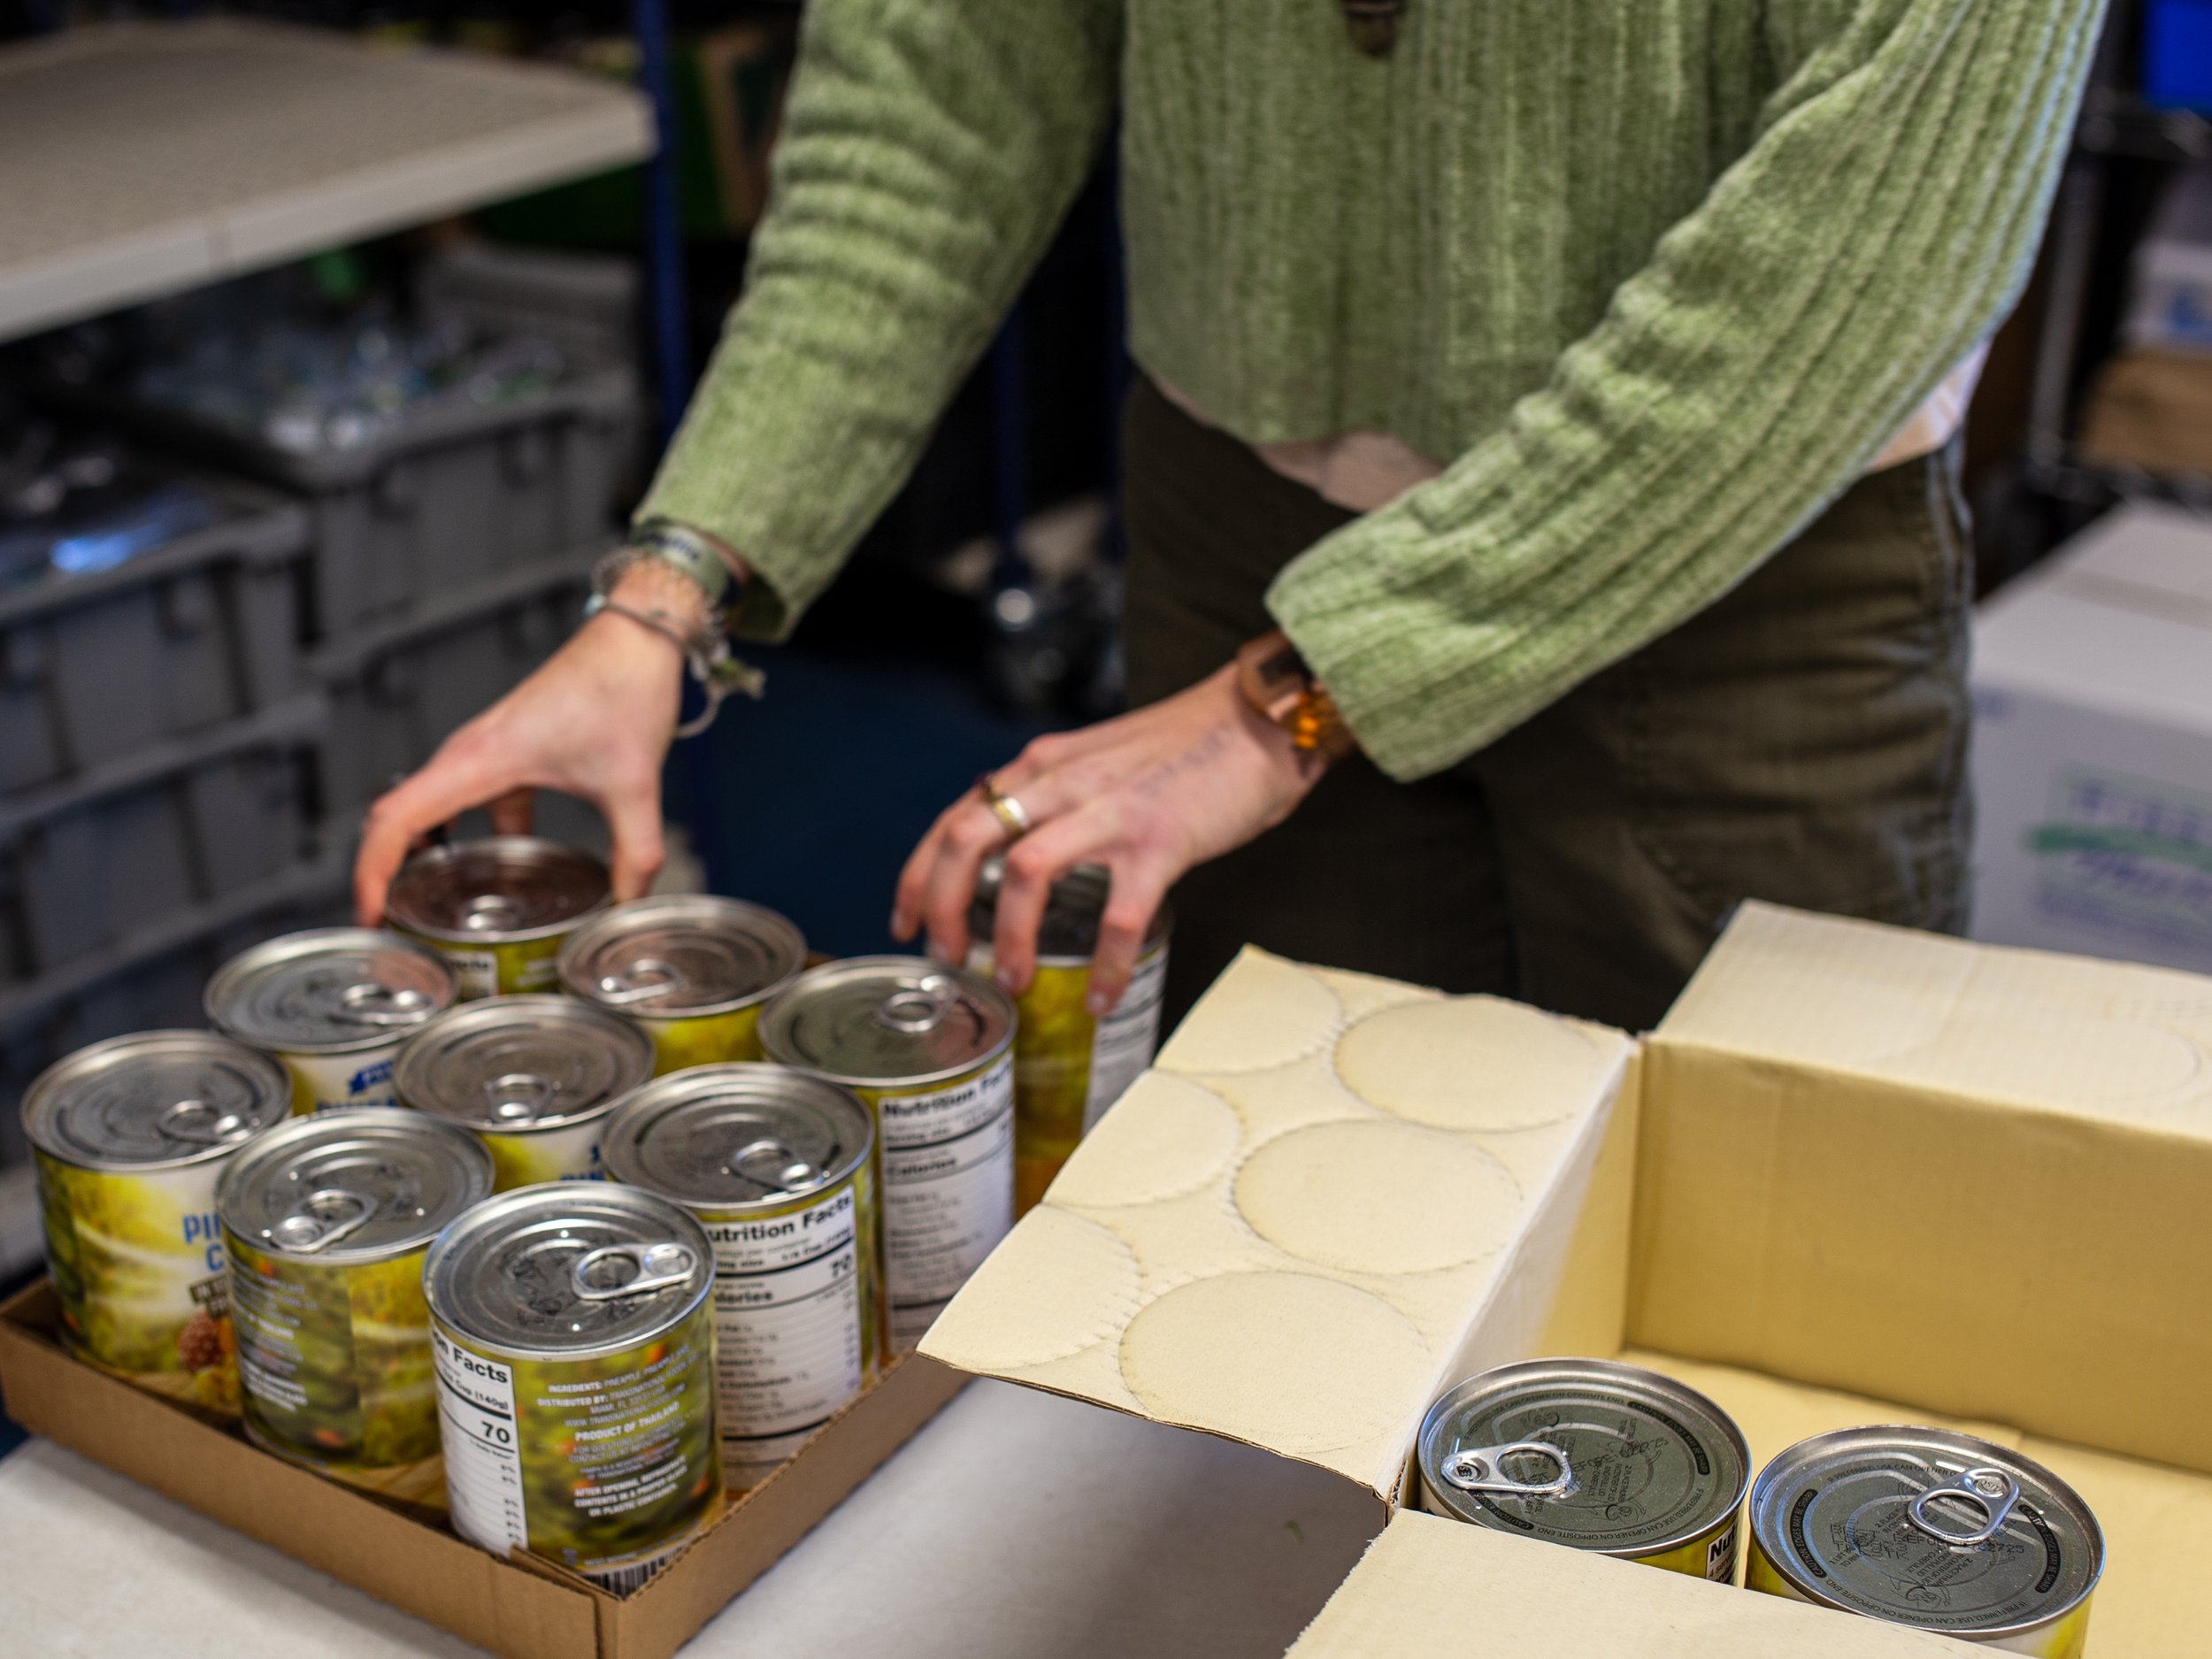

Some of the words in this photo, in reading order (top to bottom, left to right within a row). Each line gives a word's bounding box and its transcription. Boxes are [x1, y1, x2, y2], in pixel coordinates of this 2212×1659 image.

[708, 1222, 795, 1243] utrition
[453, 1347, 509, 1384] Facts
[537, 1396, 592, 1408] DISTRIBUTED
[575, 1425, 622, 1442] PRODUCT
[623, 1420, 637, 1433] OF
[638, 1401, 680, 1428] THAILAND
[480, 1420, 511, 1444] 70
[1557, 1532, 1600, 1540] OPPOSITE
[1616, 1530, 1646, 1540] OPENER
[1916, 1566, 1927, 1578] LID
[1824, 1578, 1842, 1593] END.
[1840, 1589, 1881, 1611] OPPOSITE
[1881, 1607, 1898, 1617] ON
[1897, 1610, 1934, 1624] OPENER
[1957, 1616, 1976, 1624] USE
